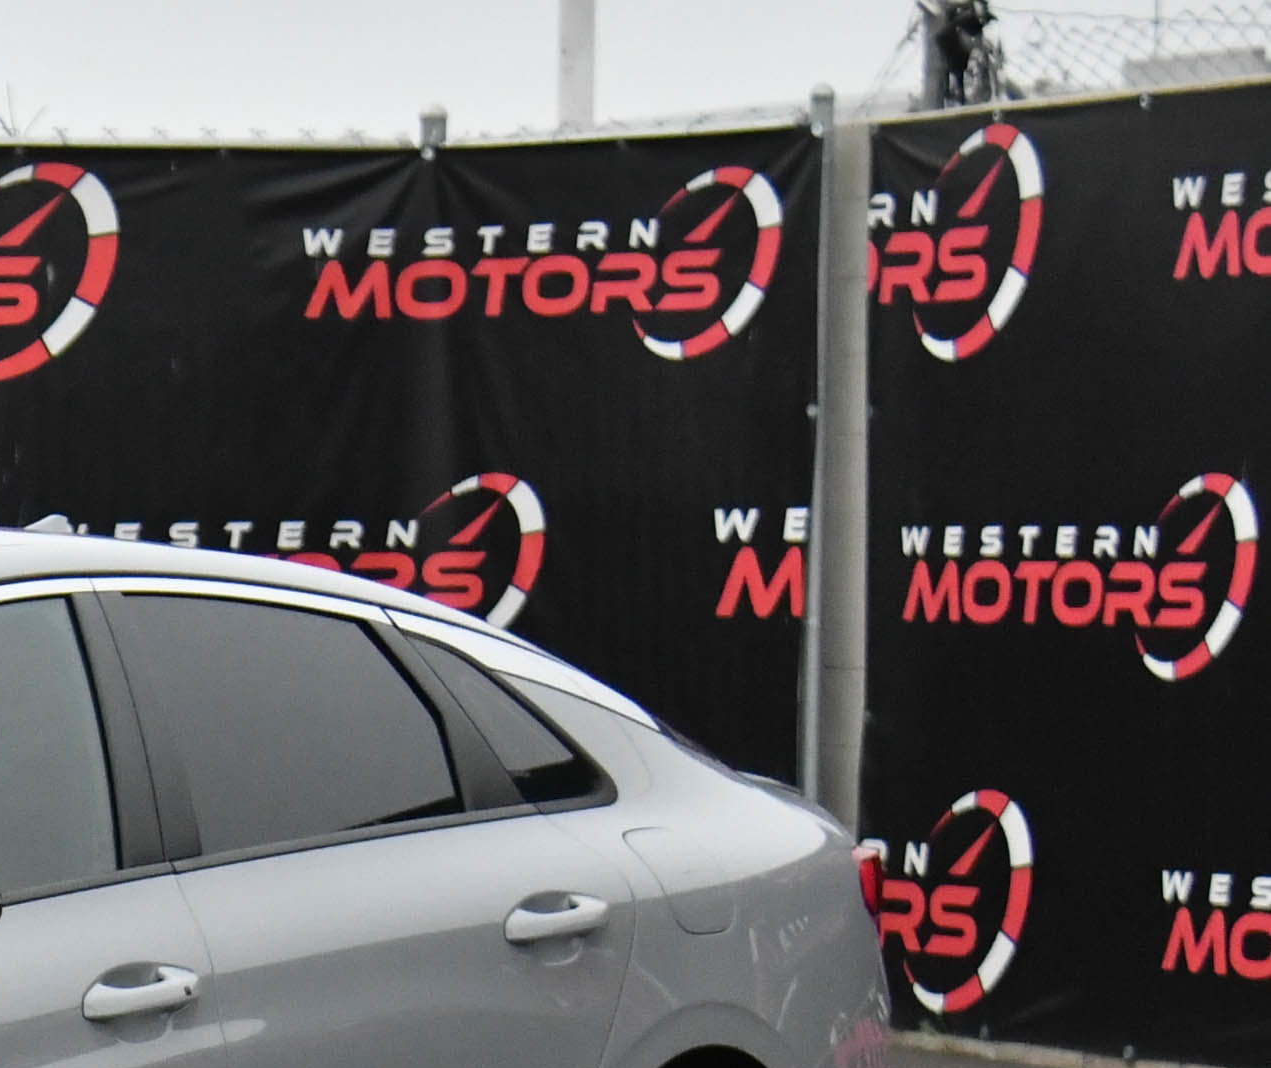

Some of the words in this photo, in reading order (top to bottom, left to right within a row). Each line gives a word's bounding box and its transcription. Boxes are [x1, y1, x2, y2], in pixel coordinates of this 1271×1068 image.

[302, 218, 659, 257] WESTERN
[305, 249, 721, 321] MOTORS
[71, 519, 418, 550] ESTERN
[901, 525, 1158, 558] WESTERN
[902, 559, 1207, 628] MOTORS
